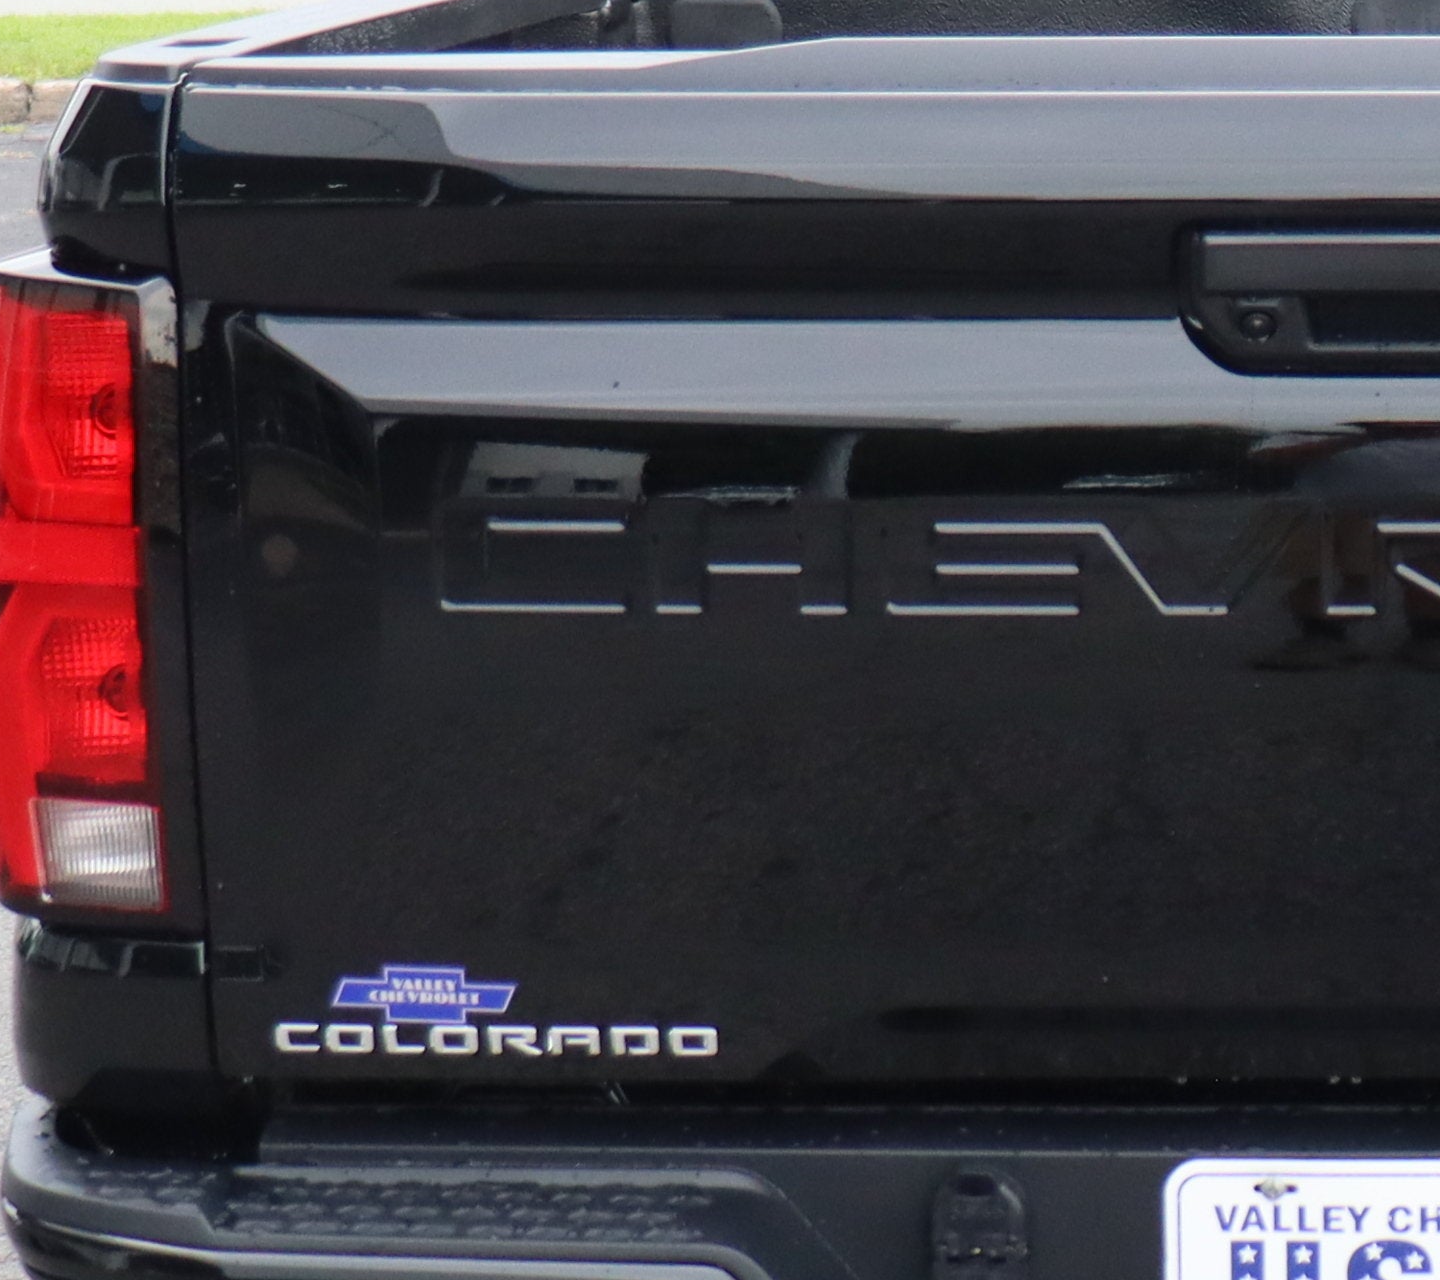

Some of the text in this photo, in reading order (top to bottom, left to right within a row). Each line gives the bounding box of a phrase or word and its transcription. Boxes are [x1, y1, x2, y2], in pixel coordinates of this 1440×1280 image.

[391, 978, 457, 992] VALLEY
[368, 990, 480, 1005] CHEVROLET
[274, 1022, 718, 1056] COLORADO
[1215, 1206, 1371, 1233] VALLEY
